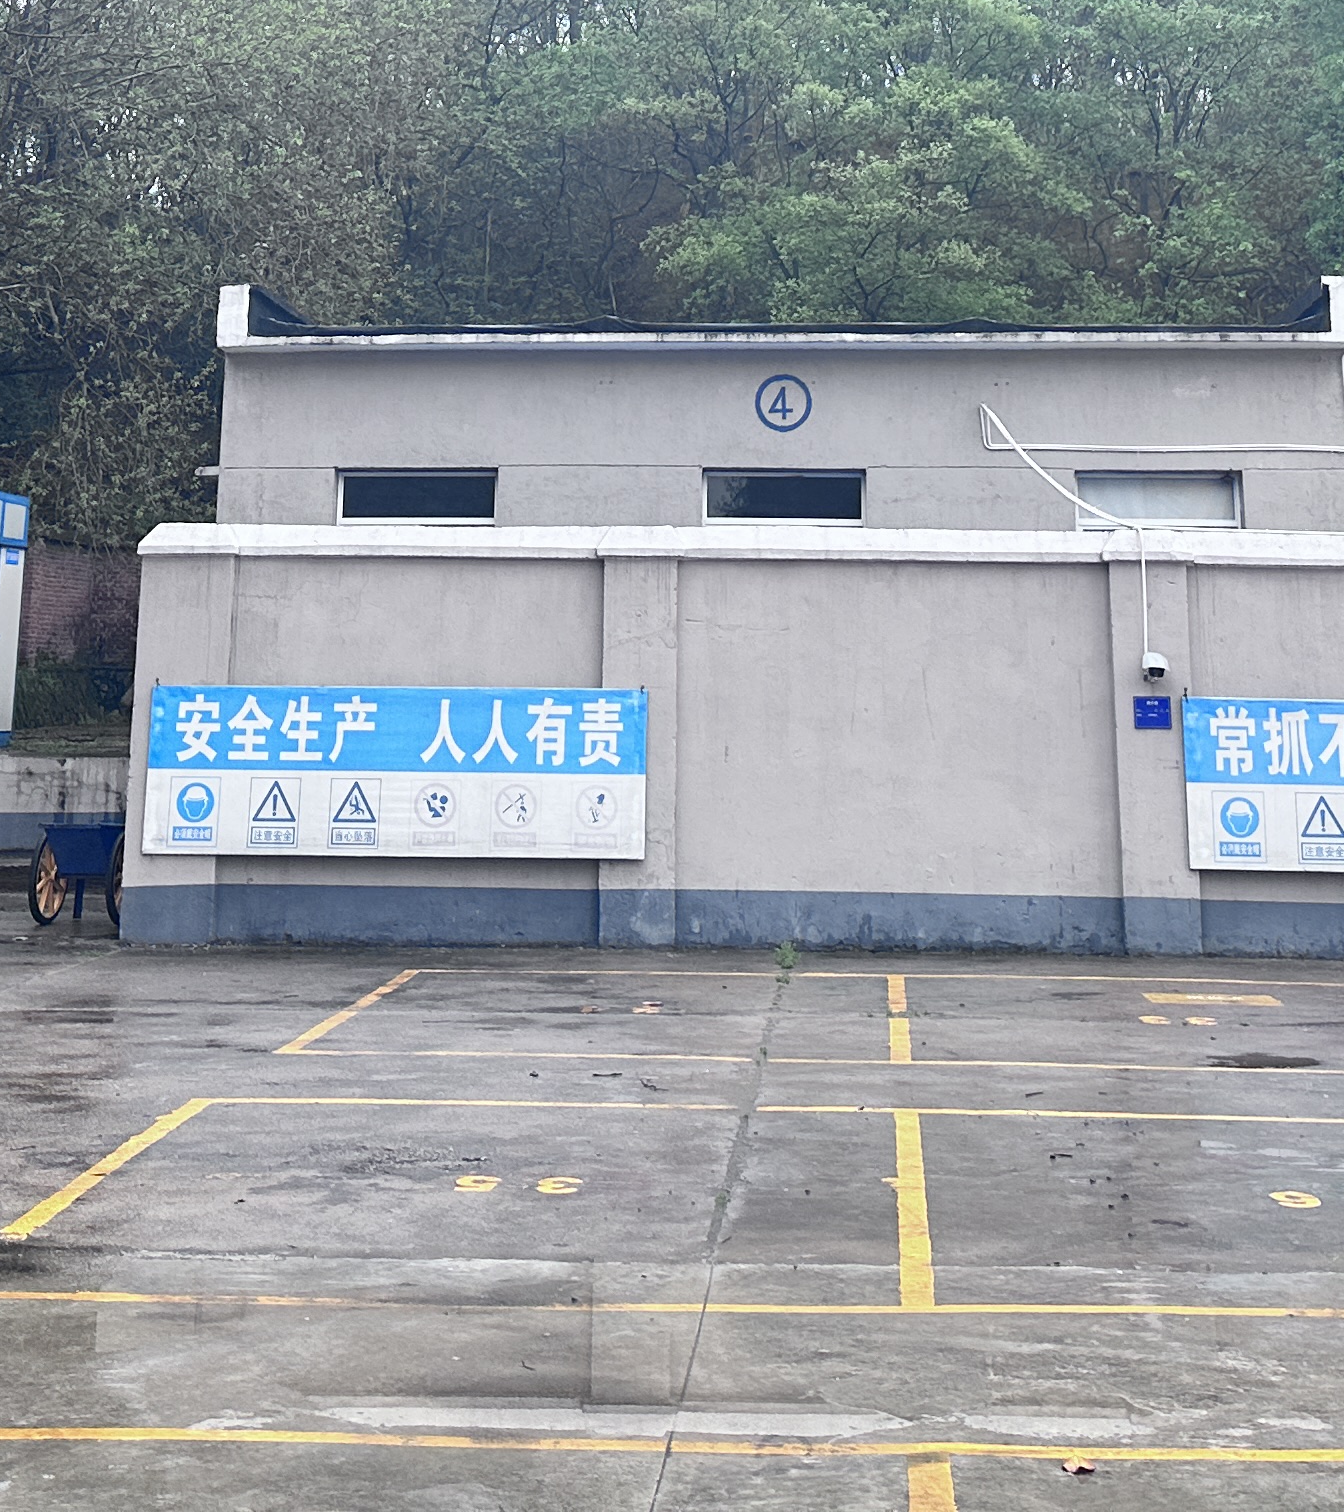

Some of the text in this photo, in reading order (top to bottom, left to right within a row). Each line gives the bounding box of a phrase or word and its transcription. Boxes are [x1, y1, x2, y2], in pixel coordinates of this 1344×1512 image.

[175, 694, 624, 767] 安全生产 人人有责
